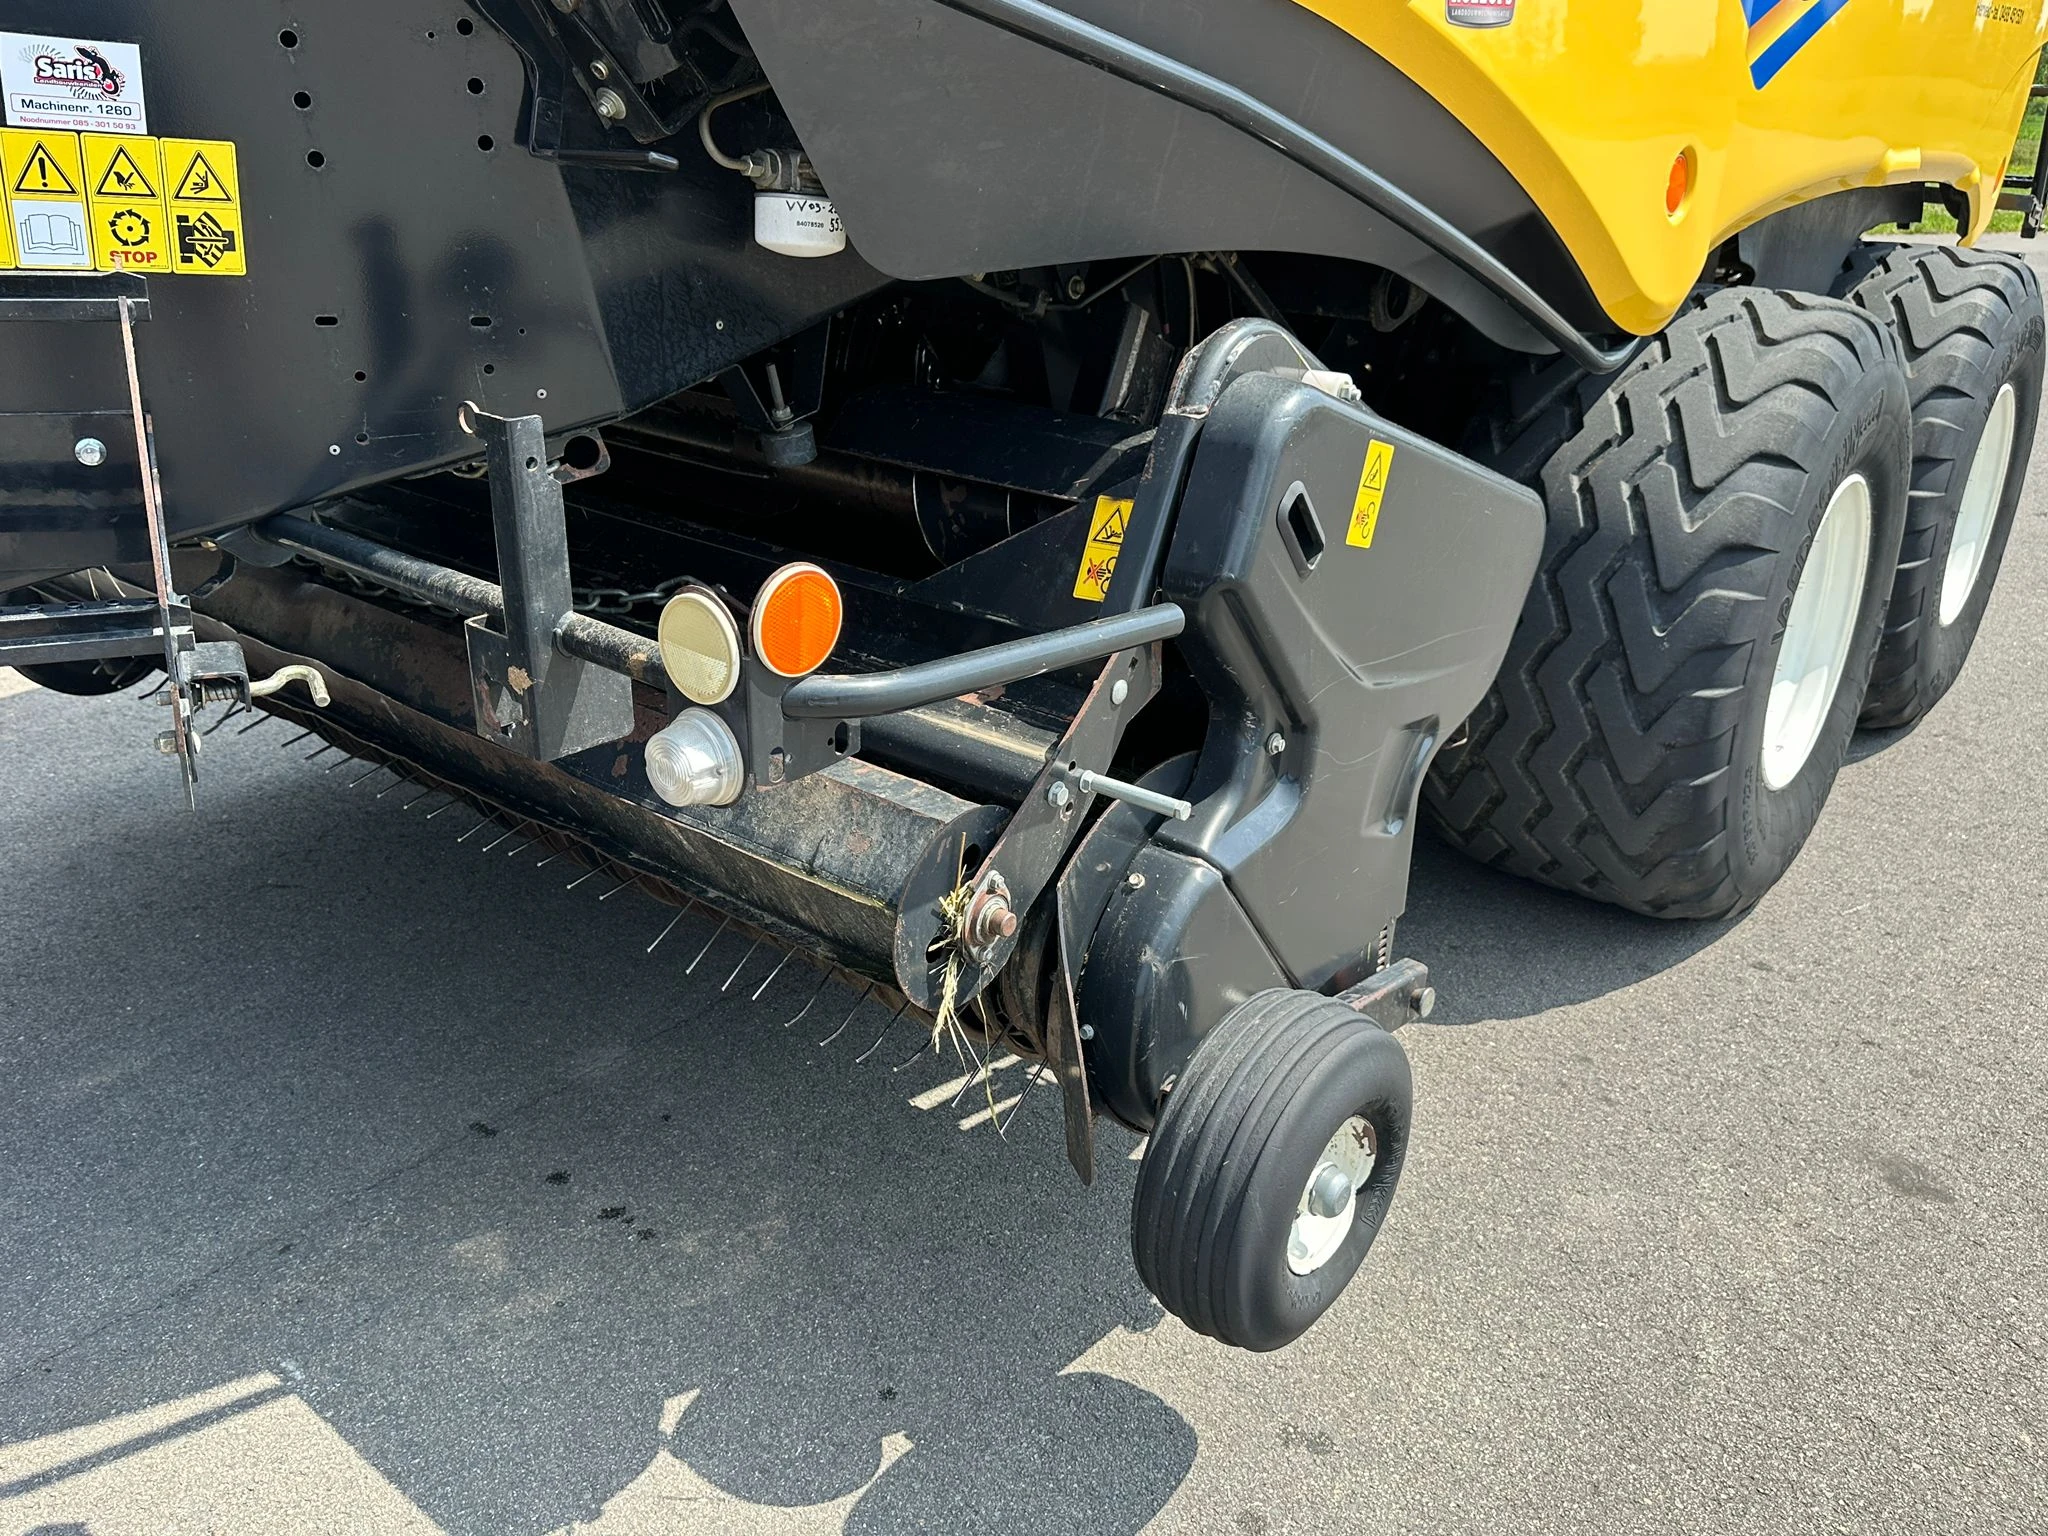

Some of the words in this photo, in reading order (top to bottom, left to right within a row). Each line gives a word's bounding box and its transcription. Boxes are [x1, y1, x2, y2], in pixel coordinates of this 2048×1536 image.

[36, 56, 97, 81] Saris
[21, 99, 92, 114] Machinenr.
[97, 104, 132, 116] 1260
[20, 116, 71, 126] Noodnummer
[73, 119, 89, 127] 085
[109, 250, 158, 264] STOP
